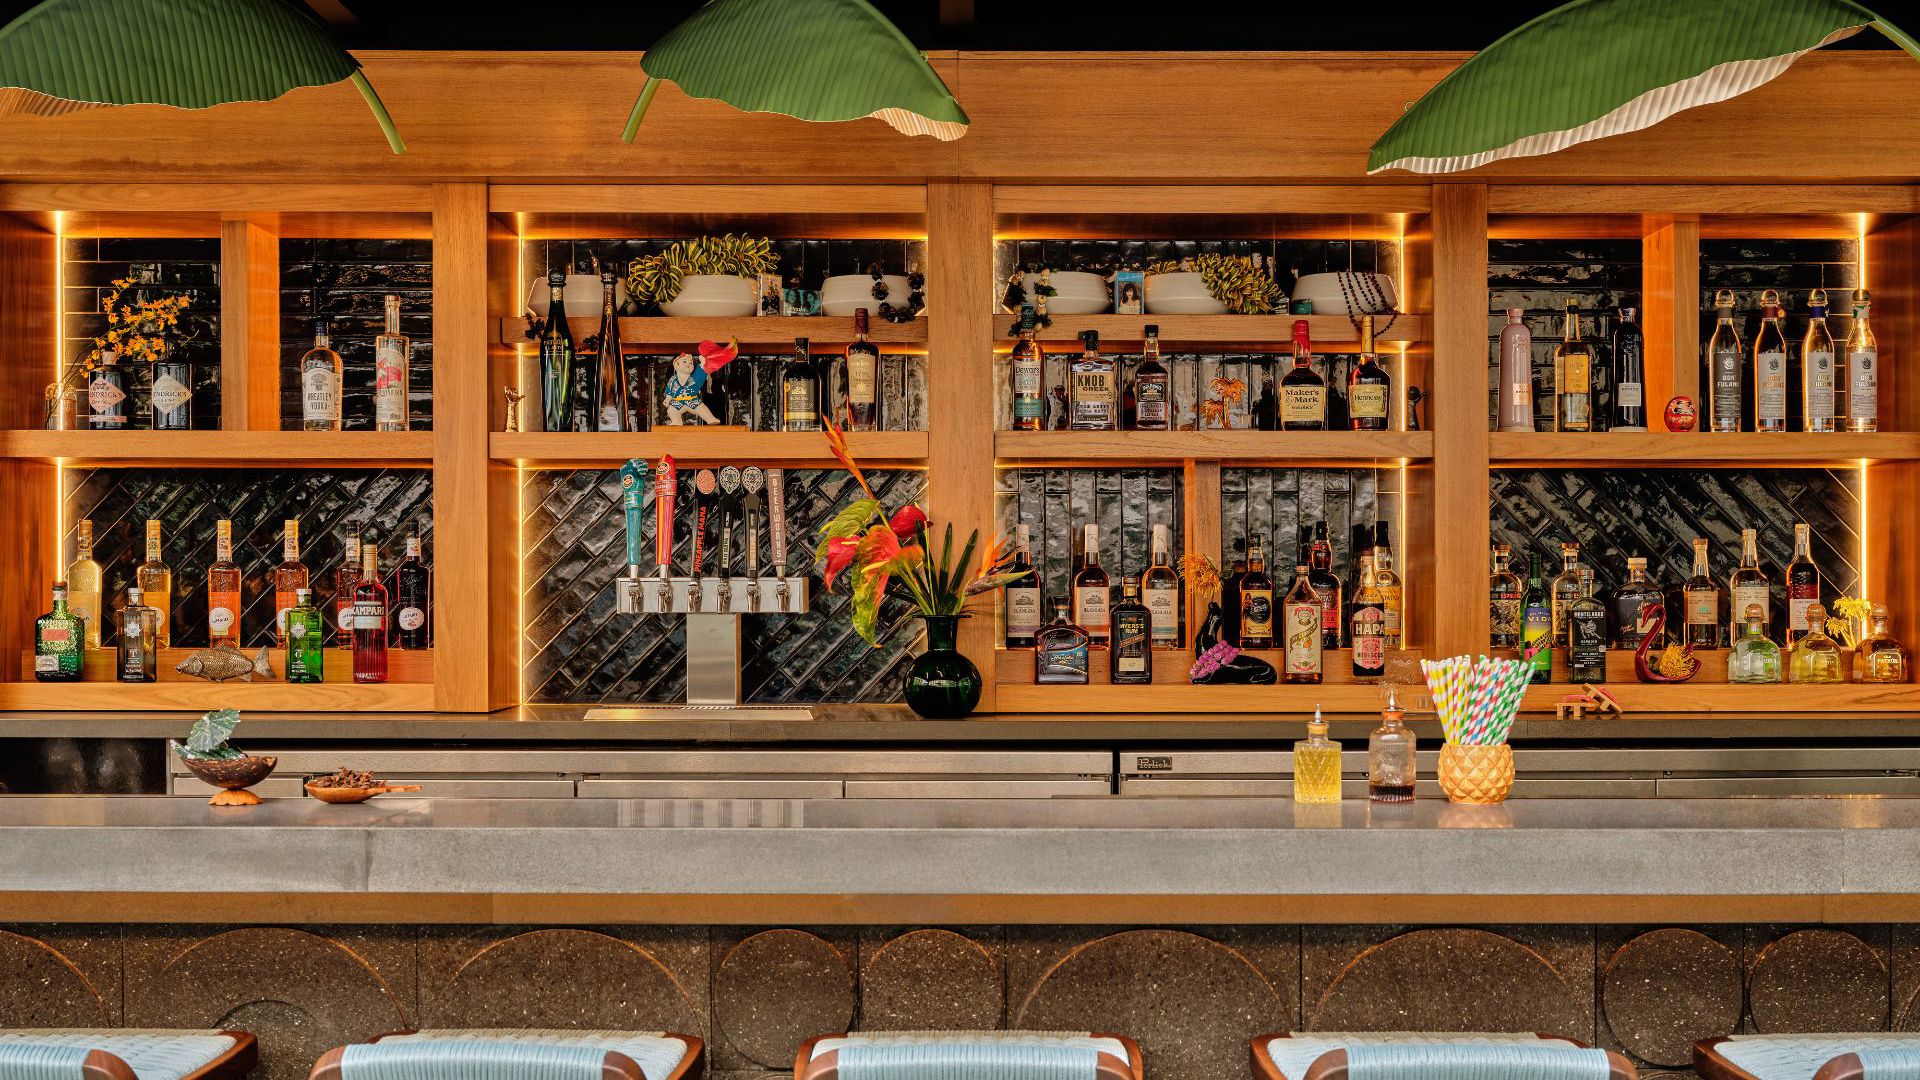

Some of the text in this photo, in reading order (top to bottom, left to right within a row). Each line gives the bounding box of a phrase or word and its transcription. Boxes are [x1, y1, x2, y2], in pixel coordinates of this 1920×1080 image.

[1077, 374, 1105, 387] KNOB
[773, 478, 782, 558] BEERWORKS
[694, 506, 707, 573] PINEAPPLE MANA
[1355, 623, 1385, 635] HAPA
